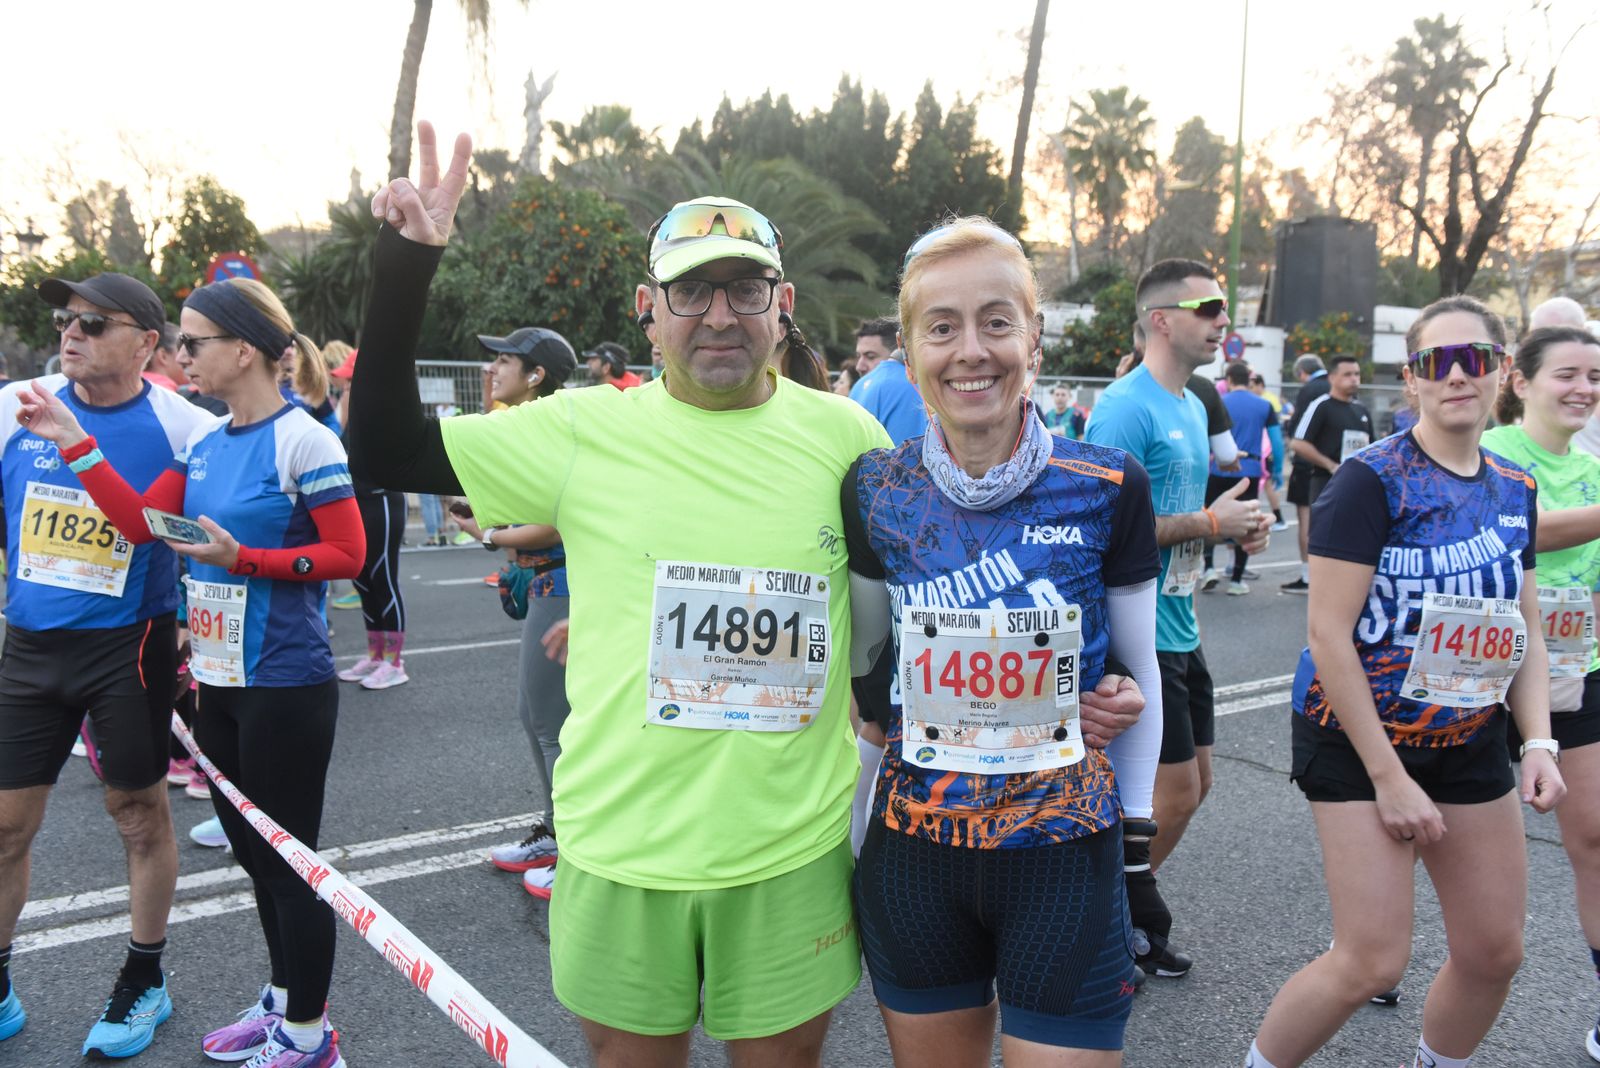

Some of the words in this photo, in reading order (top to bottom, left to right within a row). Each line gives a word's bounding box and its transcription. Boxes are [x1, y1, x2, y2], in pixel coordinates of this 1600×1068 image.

[32, 508, 114, 548] 11825
[1498, 513, 1528, 530] HOKA
[1021, 525, 1084, 545] HOKA
[1431, 526, 1507, 576] MARATÓN
[667, 565, 695, 581] MEDIO
[698, 567, 741, 585] MARATÓN
[766, 570, 811, 596] SEVILLA
[908, 549, 1024, 608] MARATÓN
[204, 584, 232, 600] SEVILLA
[668, 602, 800, 658] 14891
[911, 611, 936, 627] MEDIO
[939, 611, 981, 630] MARATÓN
[1007, 610, 1059, 633] SEVILLA
[656, 621, 664, 646] CAJÓN
[1430, 622, 1514, 659] 14188
[703, 654, 712, 662] El
[714, 656, 735, 665] Gran
[737, 657, 767, 667] Ramón
[734, 675, 757, 683] Muñoz
[915, 648, 1054, 699] 14887
[724, 711, 750, 720] HOKA
[970, 701, 997, 710] BEGO
[958, 719, 982, 727] Merino
[983, 719, 1009, 727] Álvarez
[979, 755, 1005, 764] HOKA
